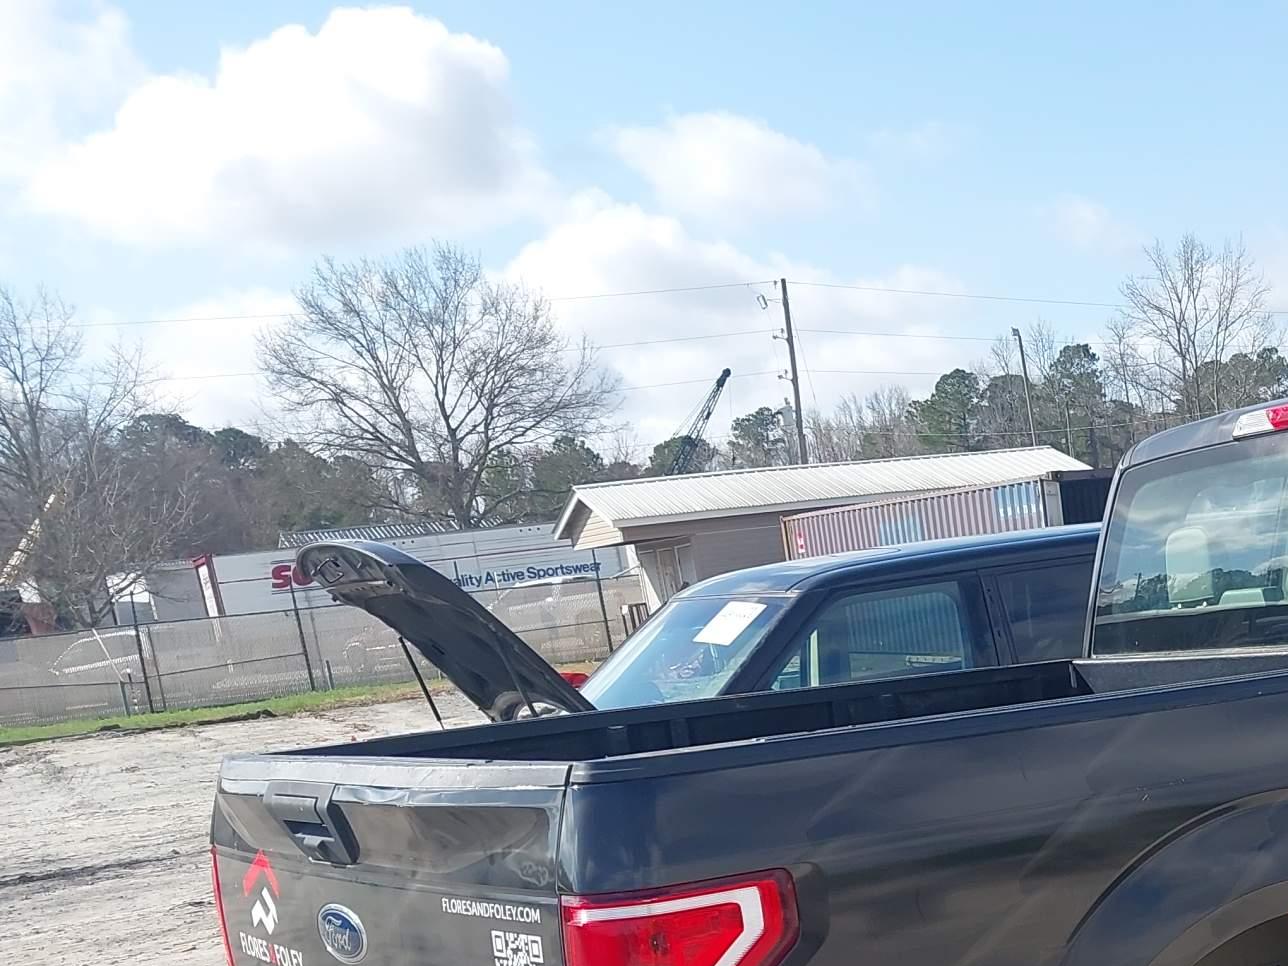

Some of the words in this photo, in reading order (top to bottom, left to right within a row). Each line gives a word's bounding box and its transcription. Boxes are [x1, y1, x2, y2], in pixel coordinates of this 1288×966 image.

[453, 574, 482, 588] ality
[484, 569, 525, 585] Active
[526, 562, 602, 580] Sportswear
[441, 897, 541, 924] FLORESANDFOLEY.COM
[239, 931, 271, 962] FLORES
